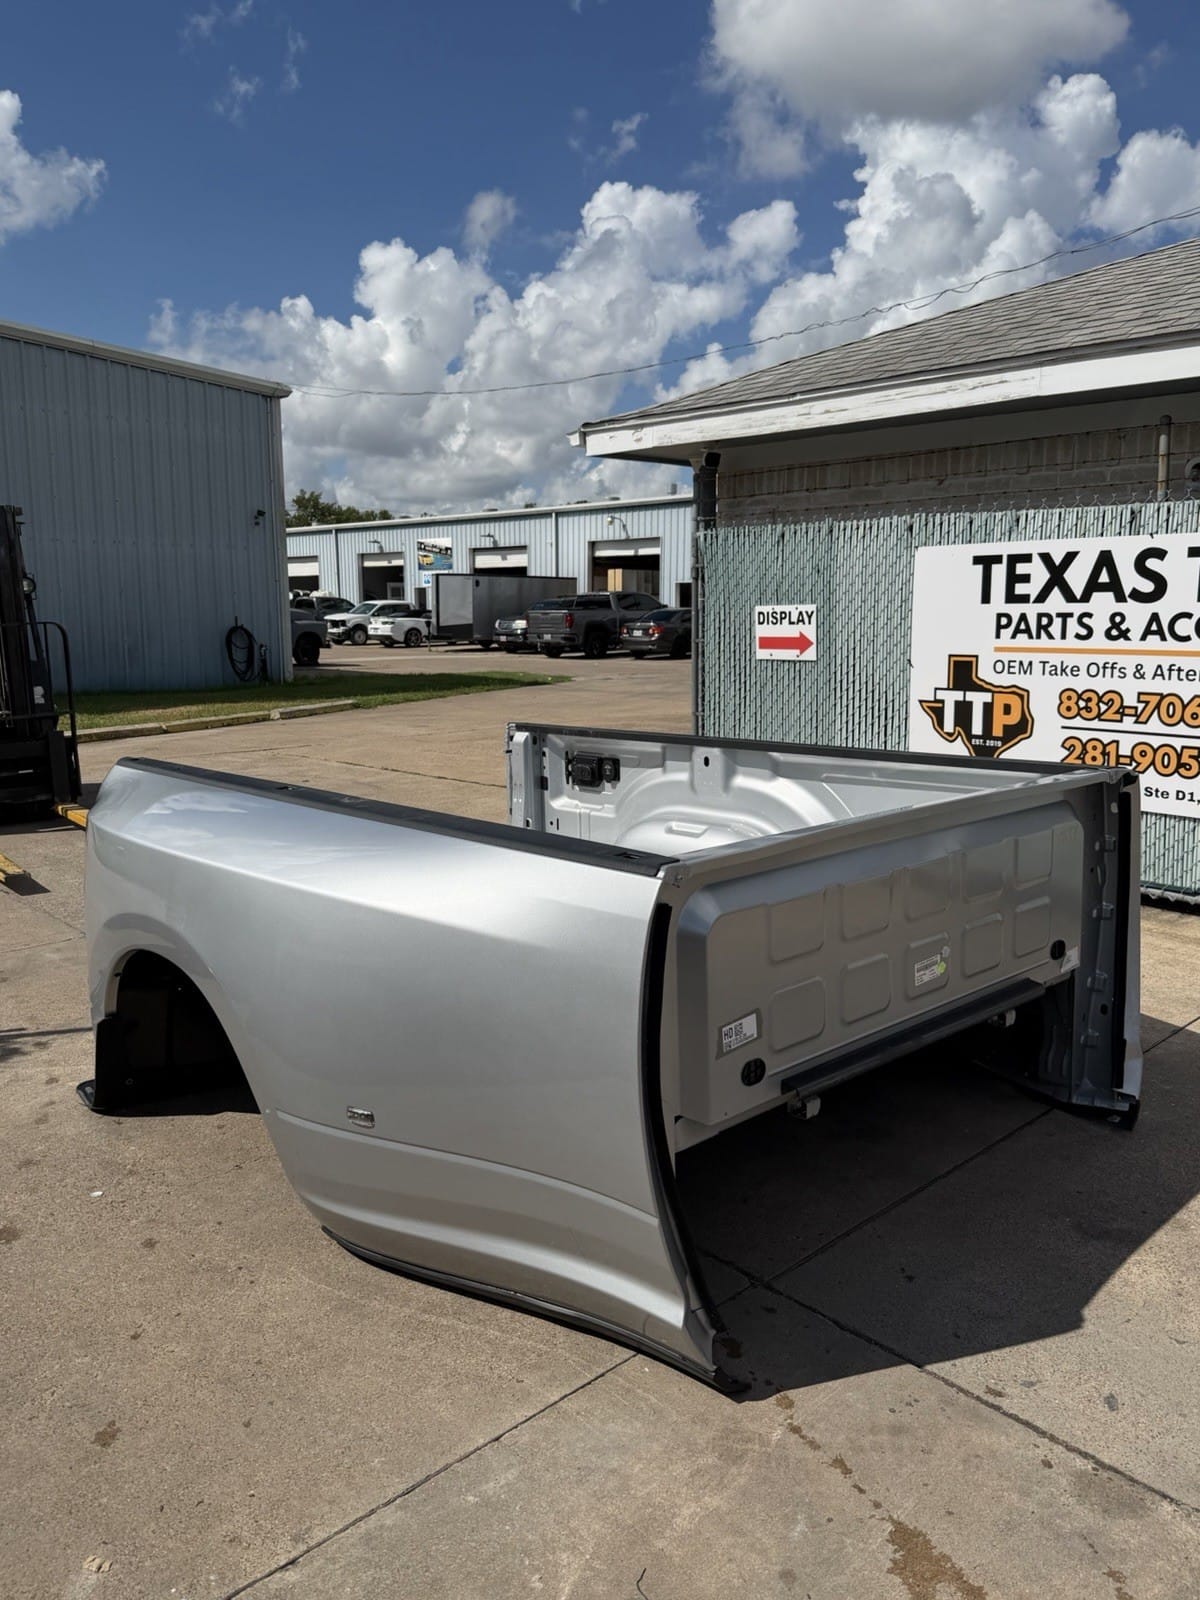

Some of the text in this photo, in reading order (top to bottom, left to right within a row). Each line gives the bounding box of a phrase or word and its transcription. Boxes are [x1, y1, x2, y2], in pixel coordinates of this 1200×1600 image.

[972, 547, 1168, 604] TEXAS
[757, 610, 815, 625] DISPLAY
[995, 612, 1200, 643] PARTS & AC
[993, 660, 1200, 682] OEM Take Offs & Afte
[934, 688, 1023, 737] TTP
[1144, 786, 1170, 799] Ste
